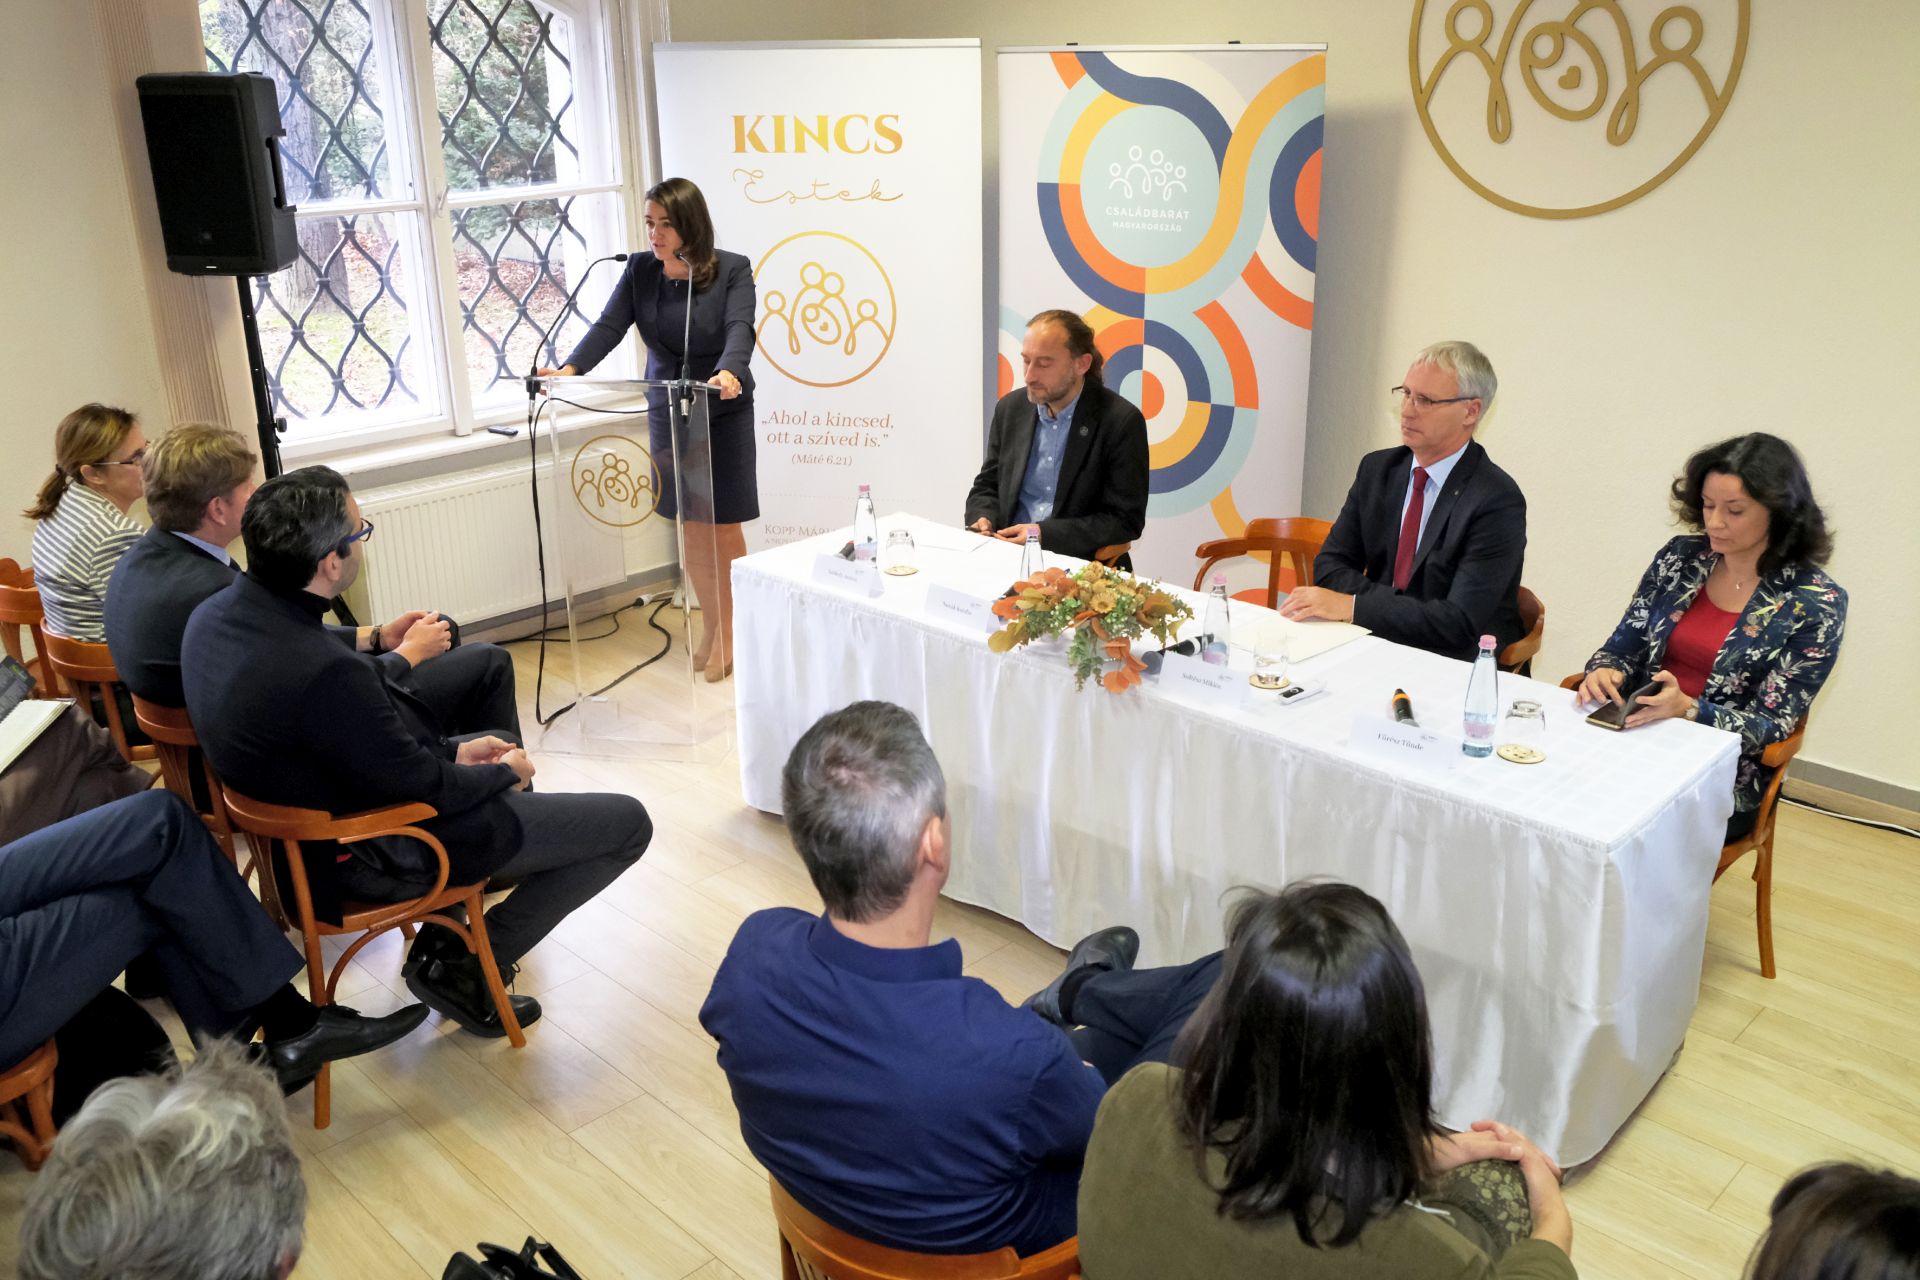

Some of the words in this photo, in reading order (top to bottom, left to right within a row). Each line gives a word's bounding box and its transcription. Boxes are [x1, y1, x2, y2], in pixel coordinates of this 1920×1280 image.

[731, 114, 903, 154] KINCS
[732, 169, 904, 204] Estek
[1106, 207, 1190, 219] CSALÁDBARÁT
[1112, 221, 1182, 233] MAGYARORSZÁG
[811, 416, 820, 426] a
[767, 431, 790, 444] ott
[794, 433, 803, 445] a
[807, 431, 859, 447] szíved
[791, 453, 824, 465] (Máté
